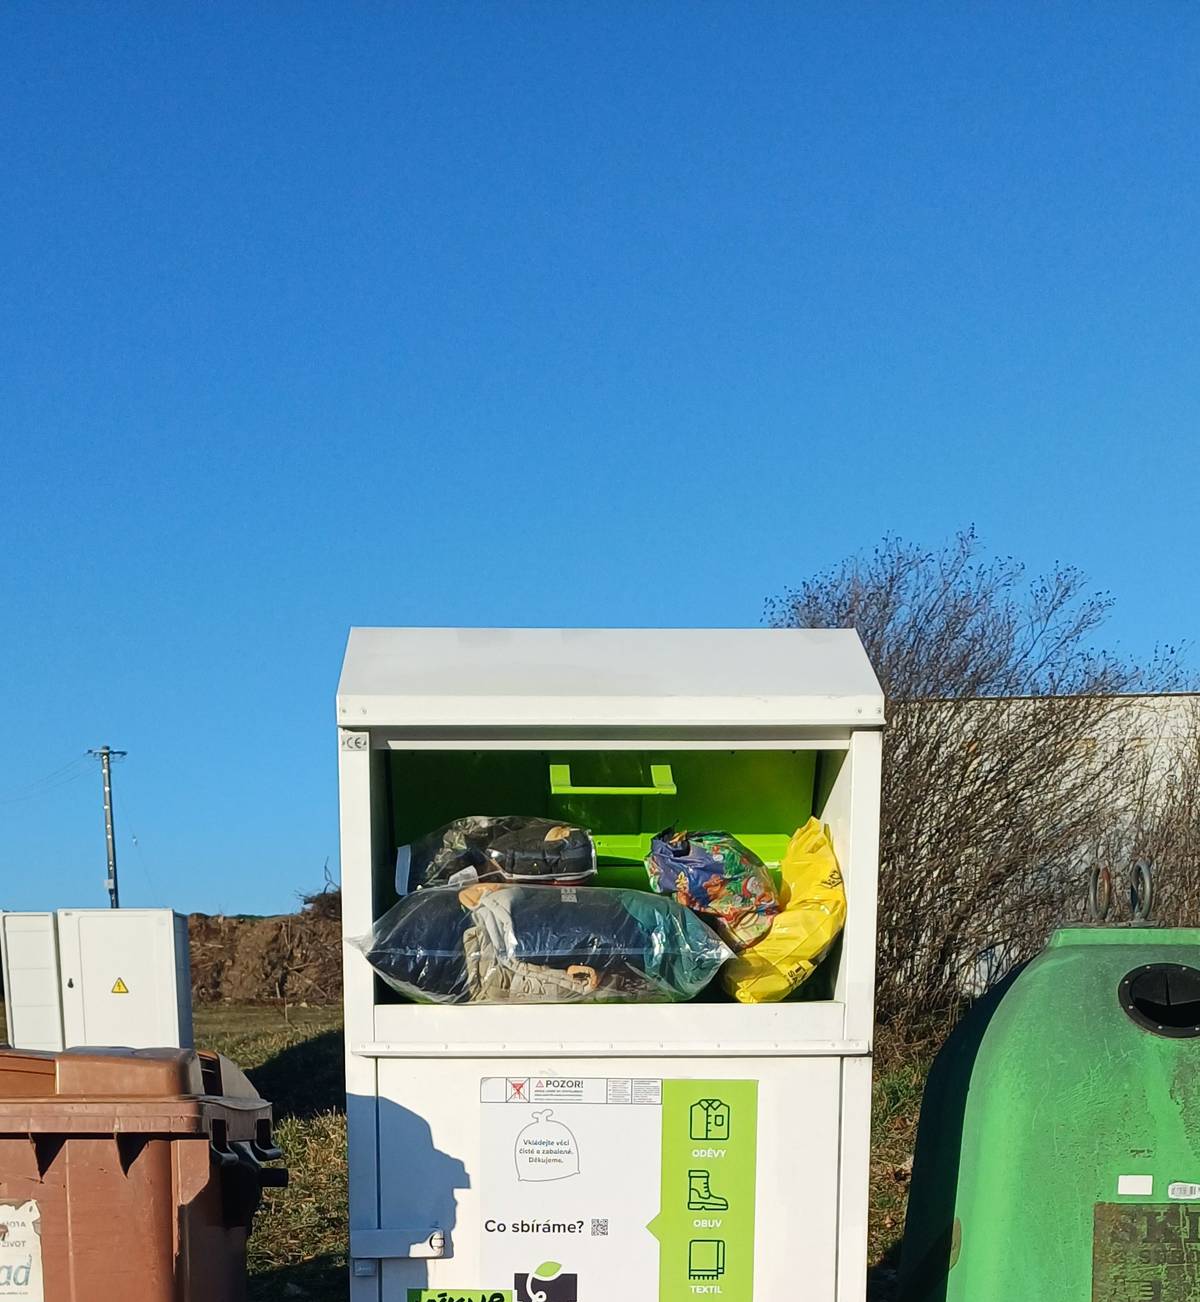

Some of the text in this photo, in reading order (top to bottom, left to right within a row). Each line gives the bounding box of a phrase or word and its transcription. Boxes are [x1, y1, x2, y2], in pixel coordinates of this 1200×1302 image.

[545, 1080, 584, 1089] POZOR!
[523, 1139, 555, 1147] Vkládejte
[692, 1148, 727, 1158] ODĚVY
[484, 1219, 585, 1233] Co sbíráme?
[693, 1219, 722, 1228] OBUV
[690, 1285, 722, 1294] TEXTIL
